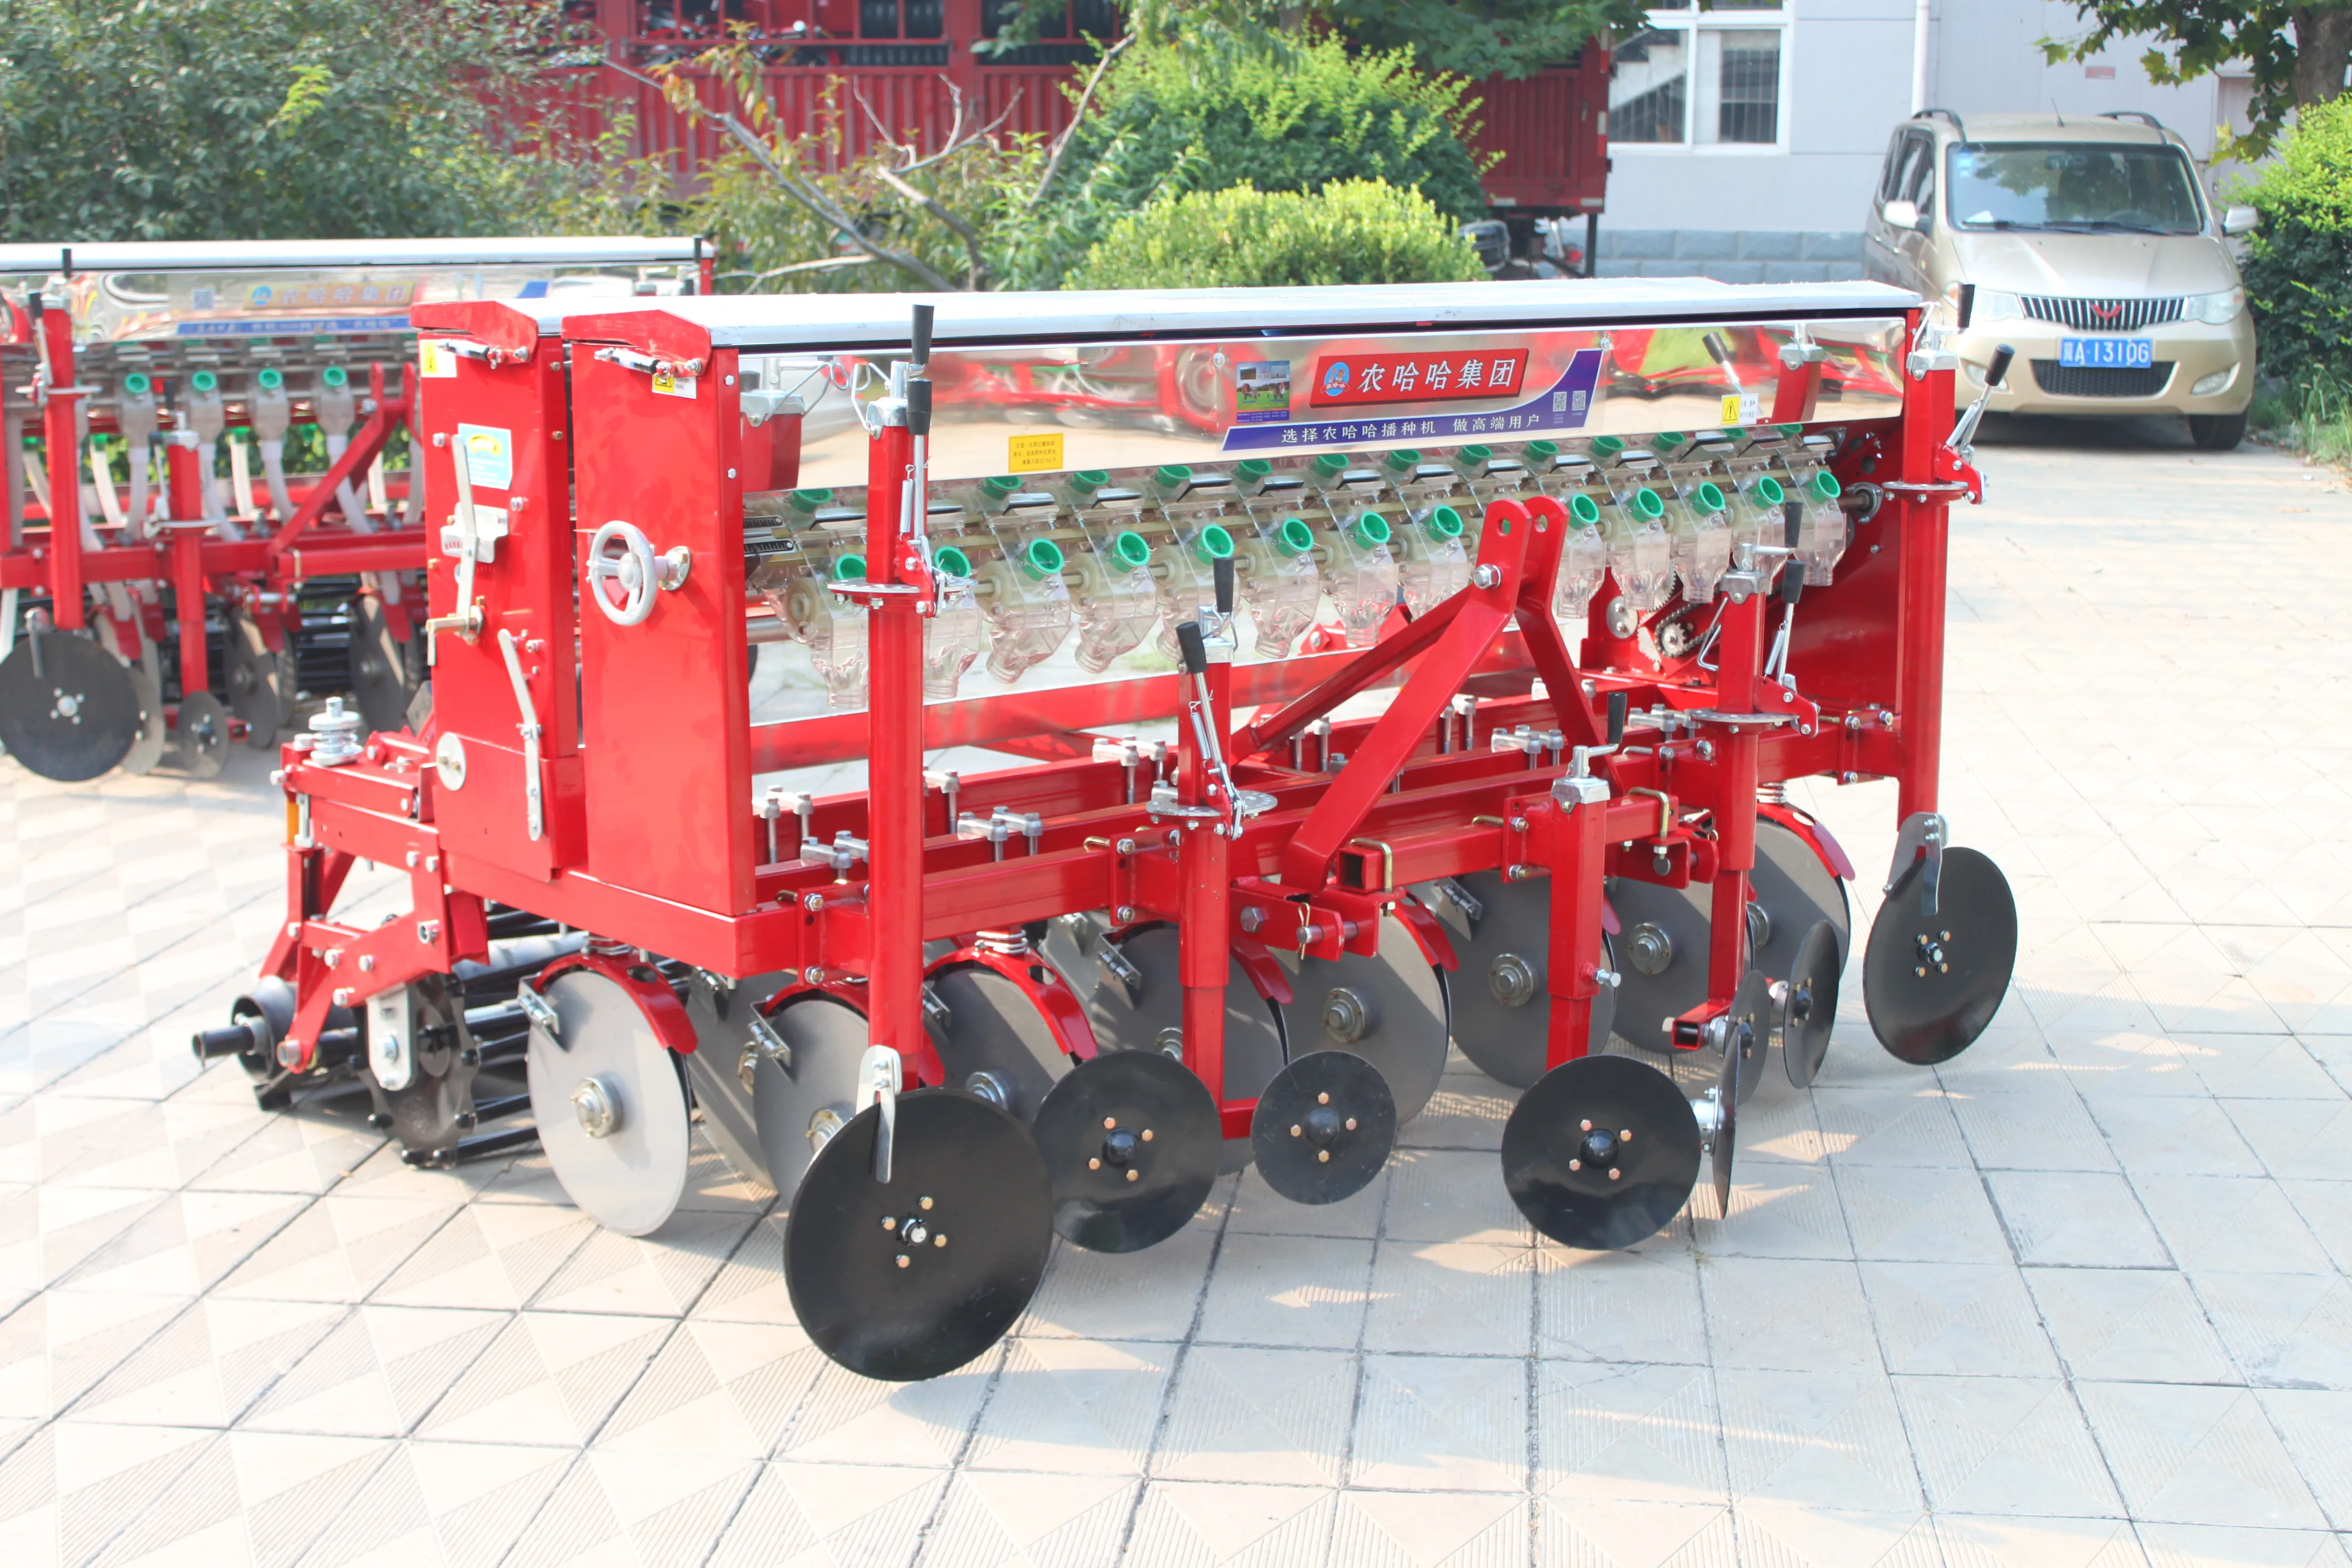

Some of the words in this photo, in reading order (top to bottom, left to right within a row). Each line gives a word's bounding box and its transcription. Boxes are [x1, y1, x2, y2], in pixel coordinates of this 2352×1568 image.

[1357, 358, 1516, 393] 农哈哈集团
[1281, 421, 1435, 443] 选择农哈哈播种机
[1453, 414, 1540, 433] 做高端用户
